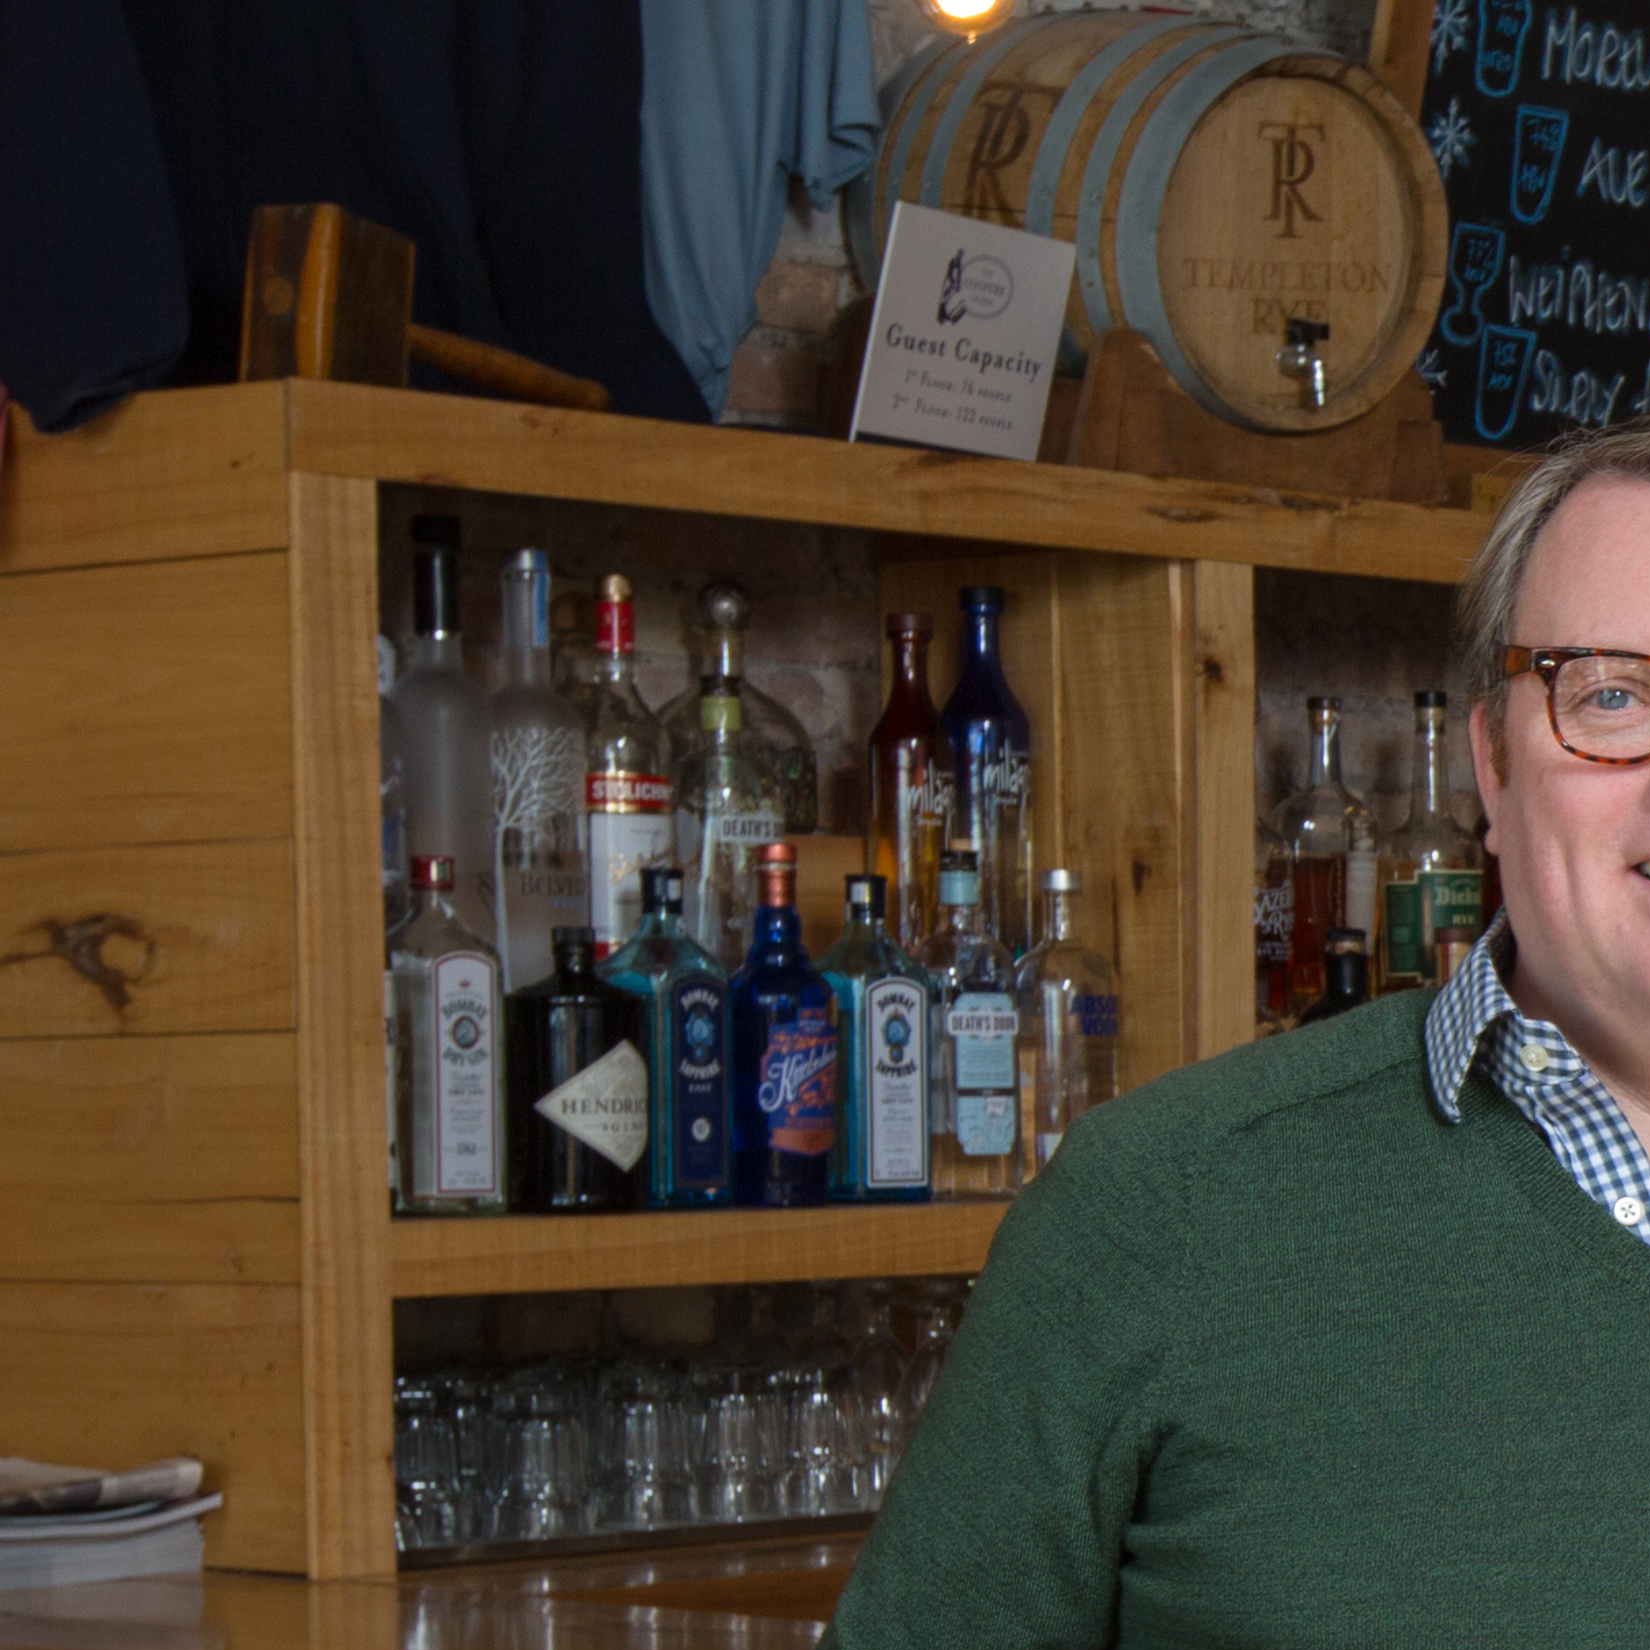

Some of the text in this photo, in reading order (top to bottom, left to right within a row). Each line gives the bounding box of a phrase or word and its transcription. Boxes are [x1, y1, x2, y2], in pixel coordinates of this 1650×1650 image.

[1576, 136, 1650, 208] ALE
[1184, 257, 1394, 294] TEMPLETON
[886, 323, 1043, 384] Guest Capacity
[681, 988, 719, 1013] BOMBAY
[877, 993, 915, 1013] BOMBAY
[951, 1014, 991, 1032] DEATH'S
